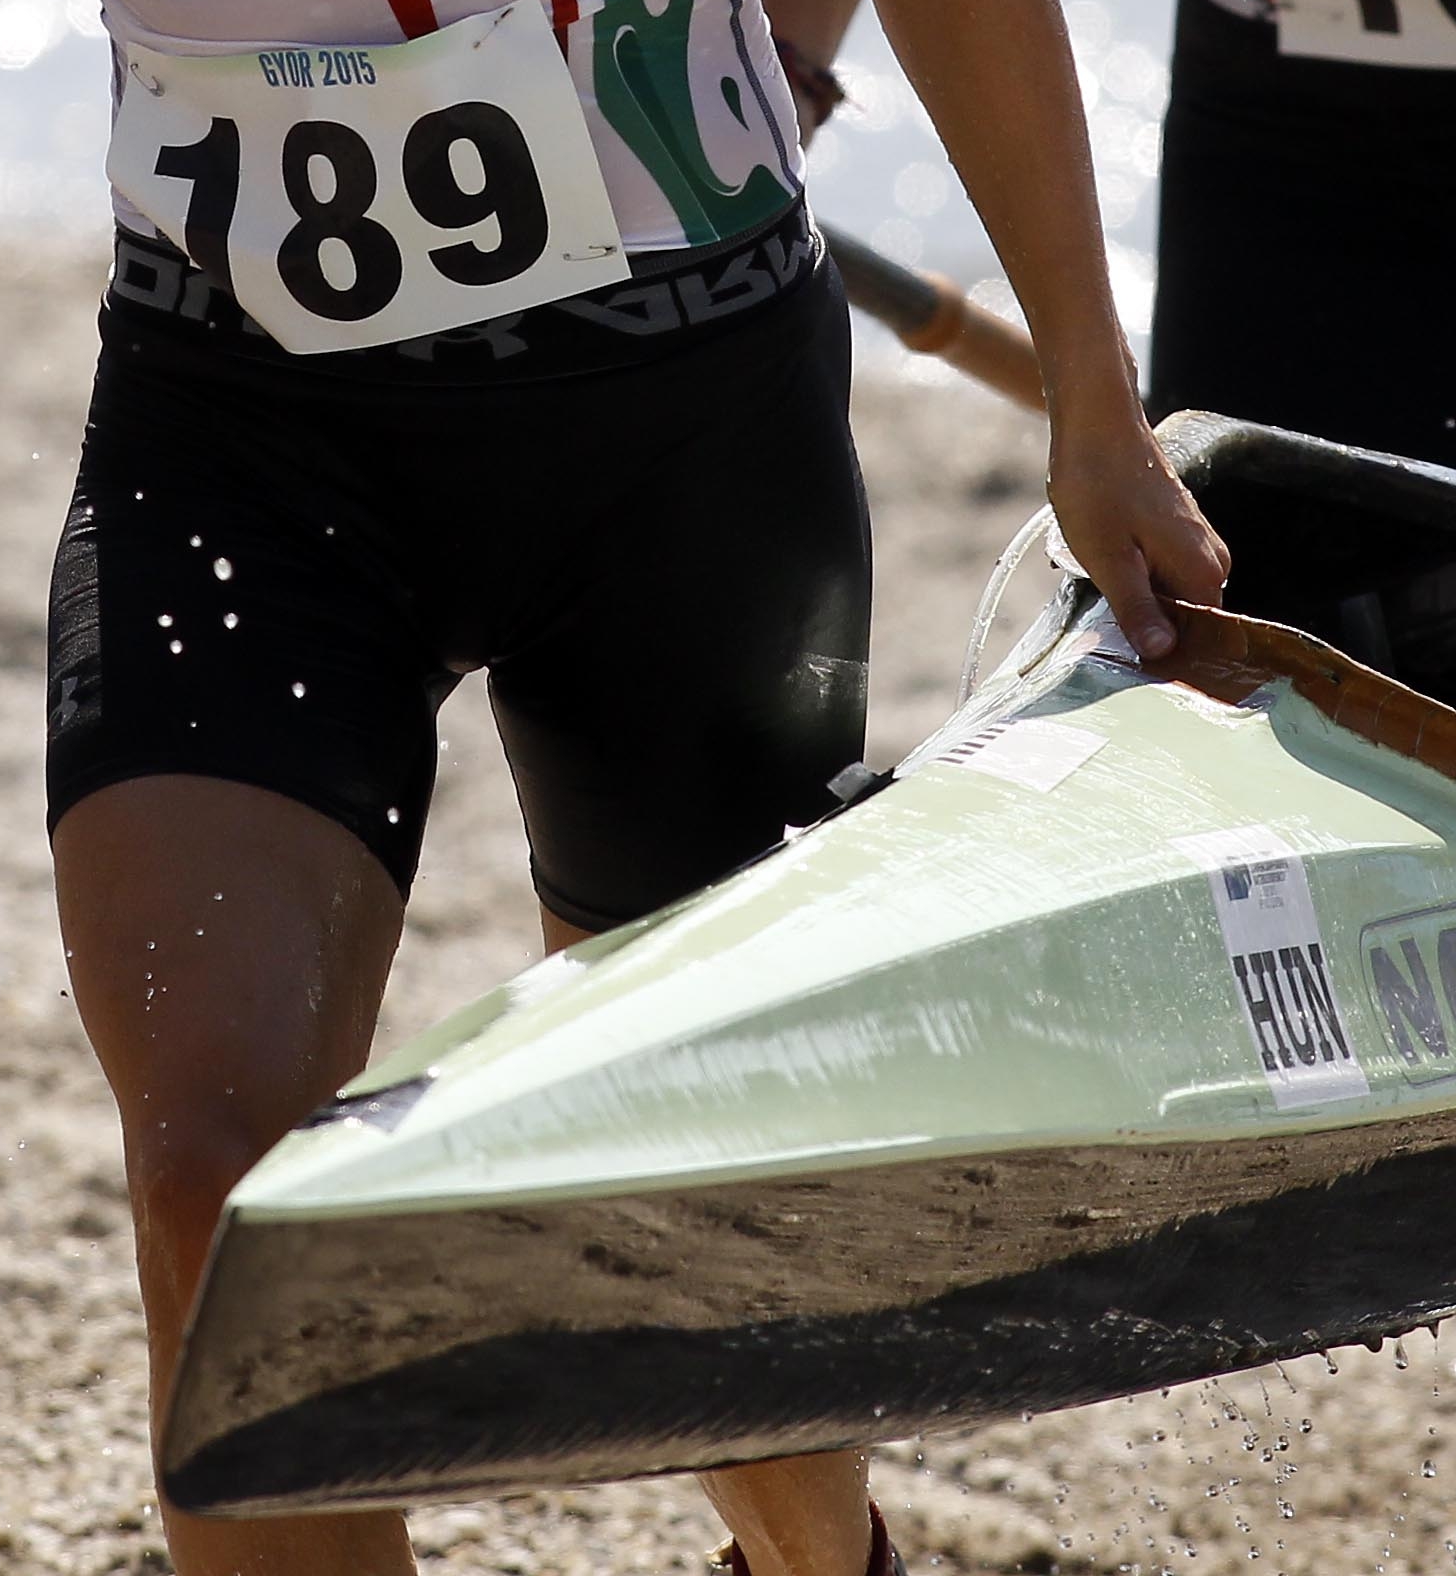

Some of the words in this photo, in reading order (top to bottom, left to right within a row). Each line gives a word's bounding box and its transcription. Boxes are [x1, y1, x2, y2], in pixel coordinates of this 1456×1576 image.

[318, 50, 376, 86] 2015
[154, 100, 550, 322] 189
[1232, 942, 1351, 1072] HUN
